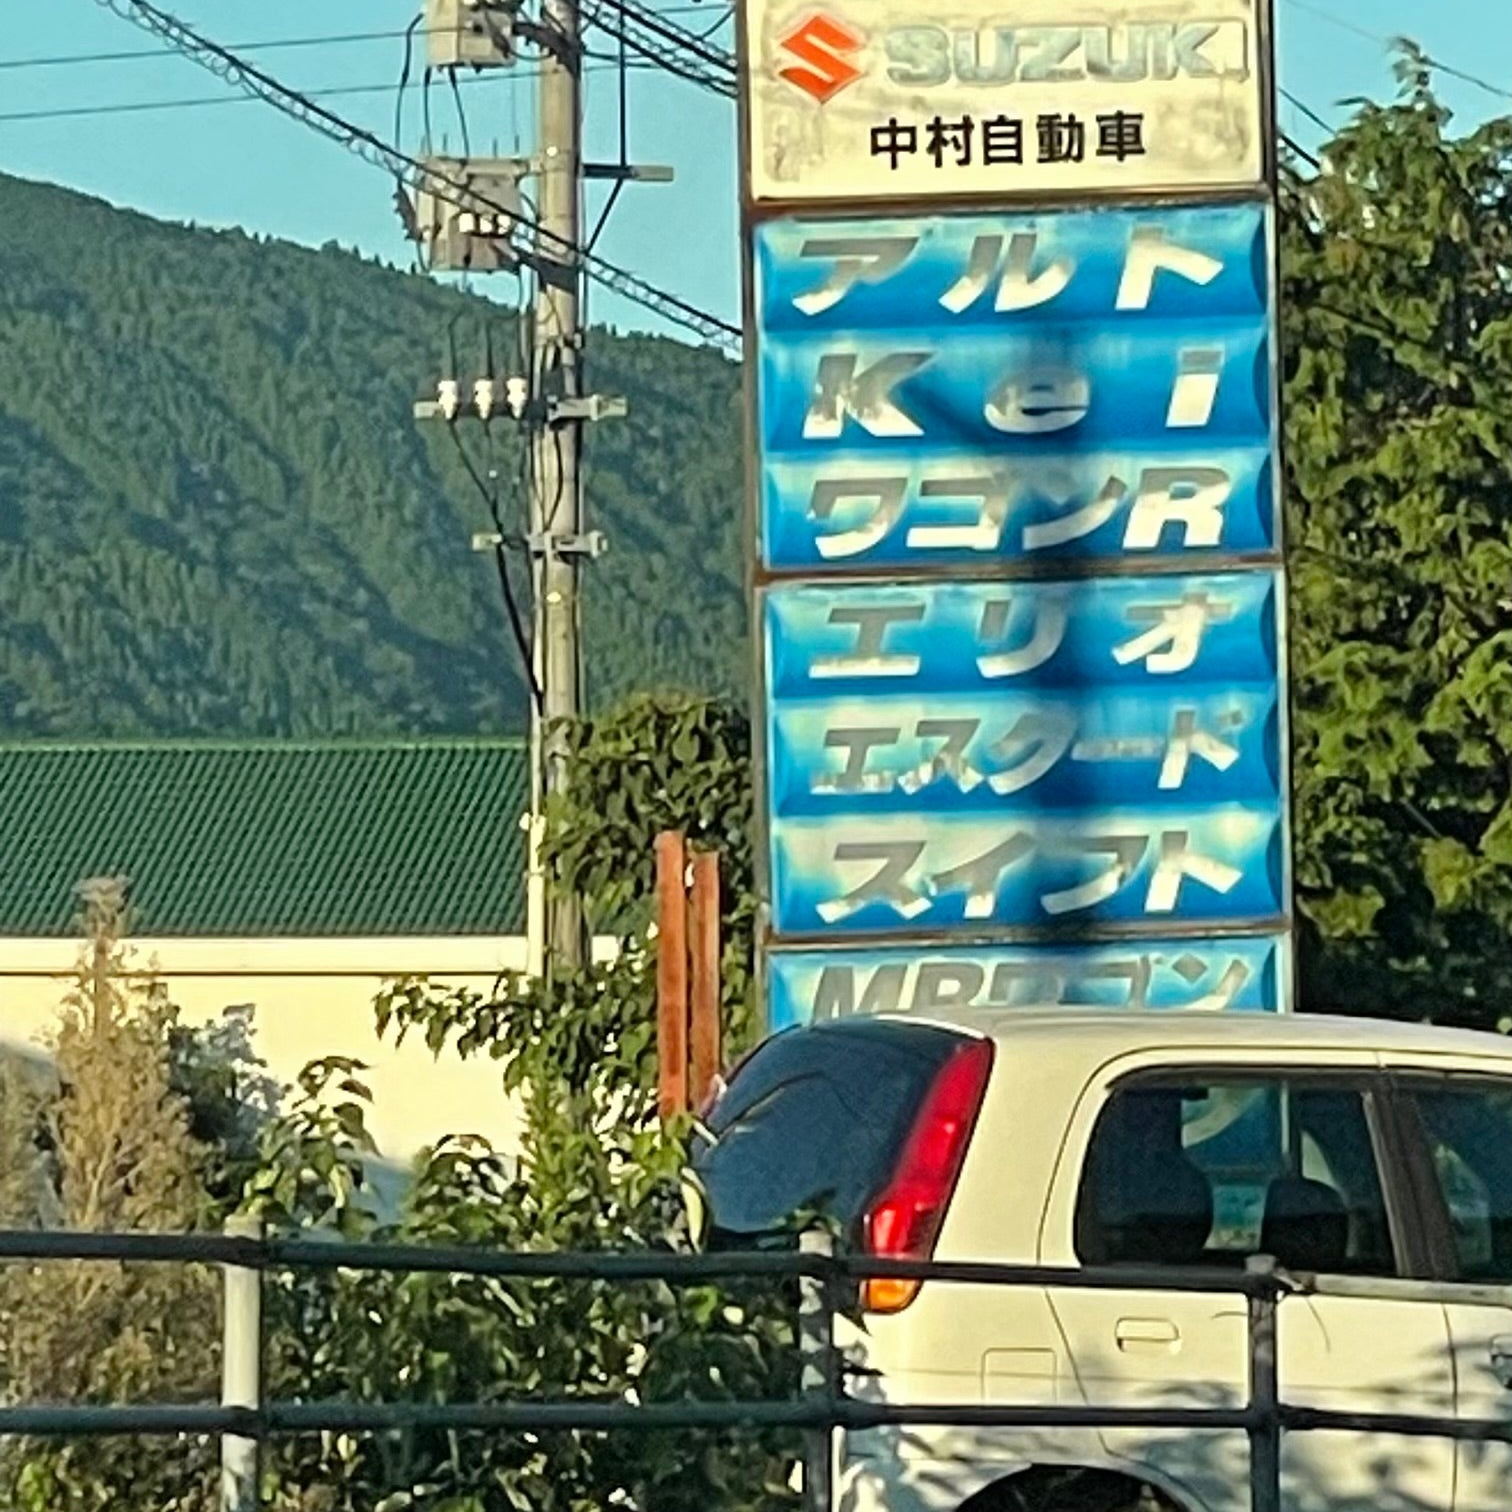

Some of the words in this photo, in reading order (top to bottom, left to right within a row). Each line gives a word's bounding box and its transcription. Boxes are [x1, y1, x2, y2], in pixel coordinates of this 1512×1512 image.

[870, 110, 1145, 170] 中村自動車
[792, 223, 1224, 316] アルト
[803, 348, 1226, 440] Kei
[809, 593, 1234, 678] エリオ
[810, 709, 1244, 794] エスクード
[816, 831, 1243, 923] スイフト
